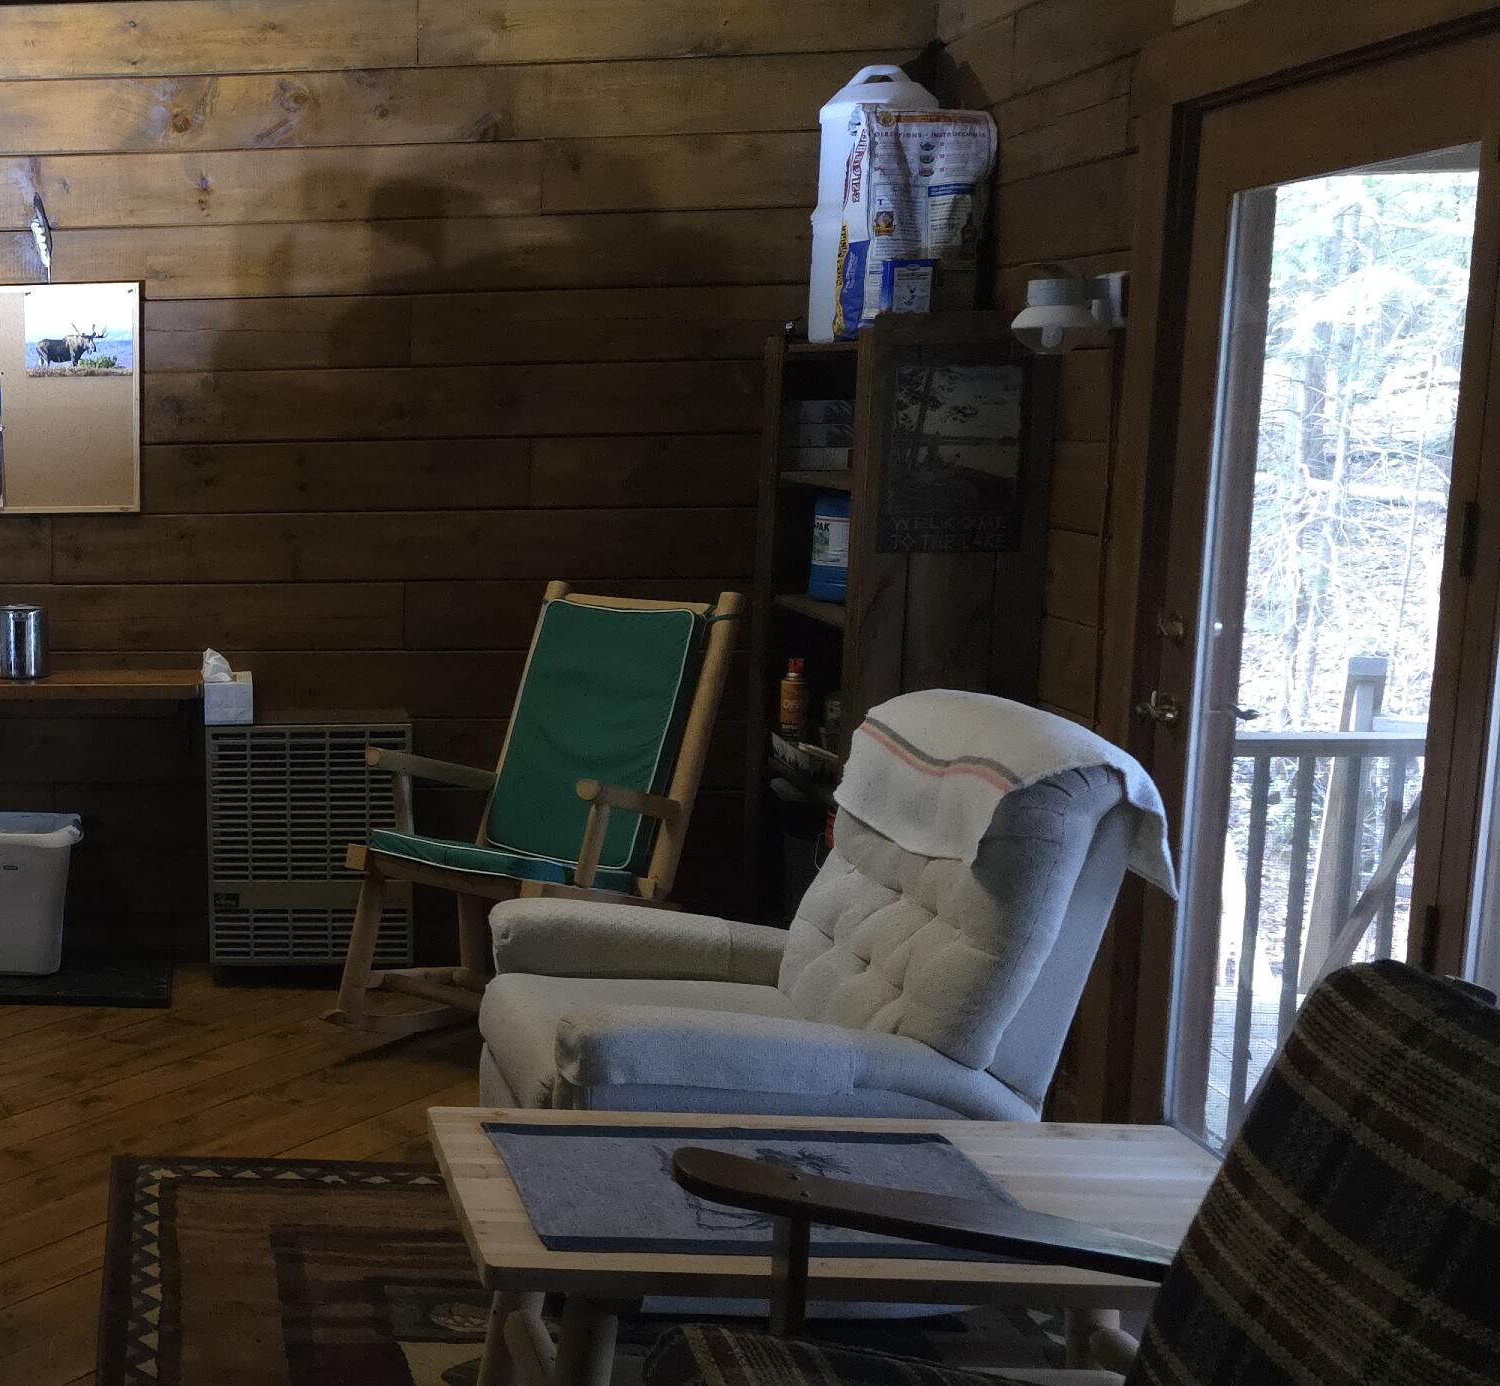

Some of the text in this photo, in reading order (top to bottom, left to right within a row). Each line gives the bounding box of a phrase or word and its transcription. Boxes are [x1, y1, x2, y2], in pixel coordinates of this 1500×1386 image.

[891, 515, 1007, 530] WELCOME
[889, 532, 1008, 550] TO THE LAKE
